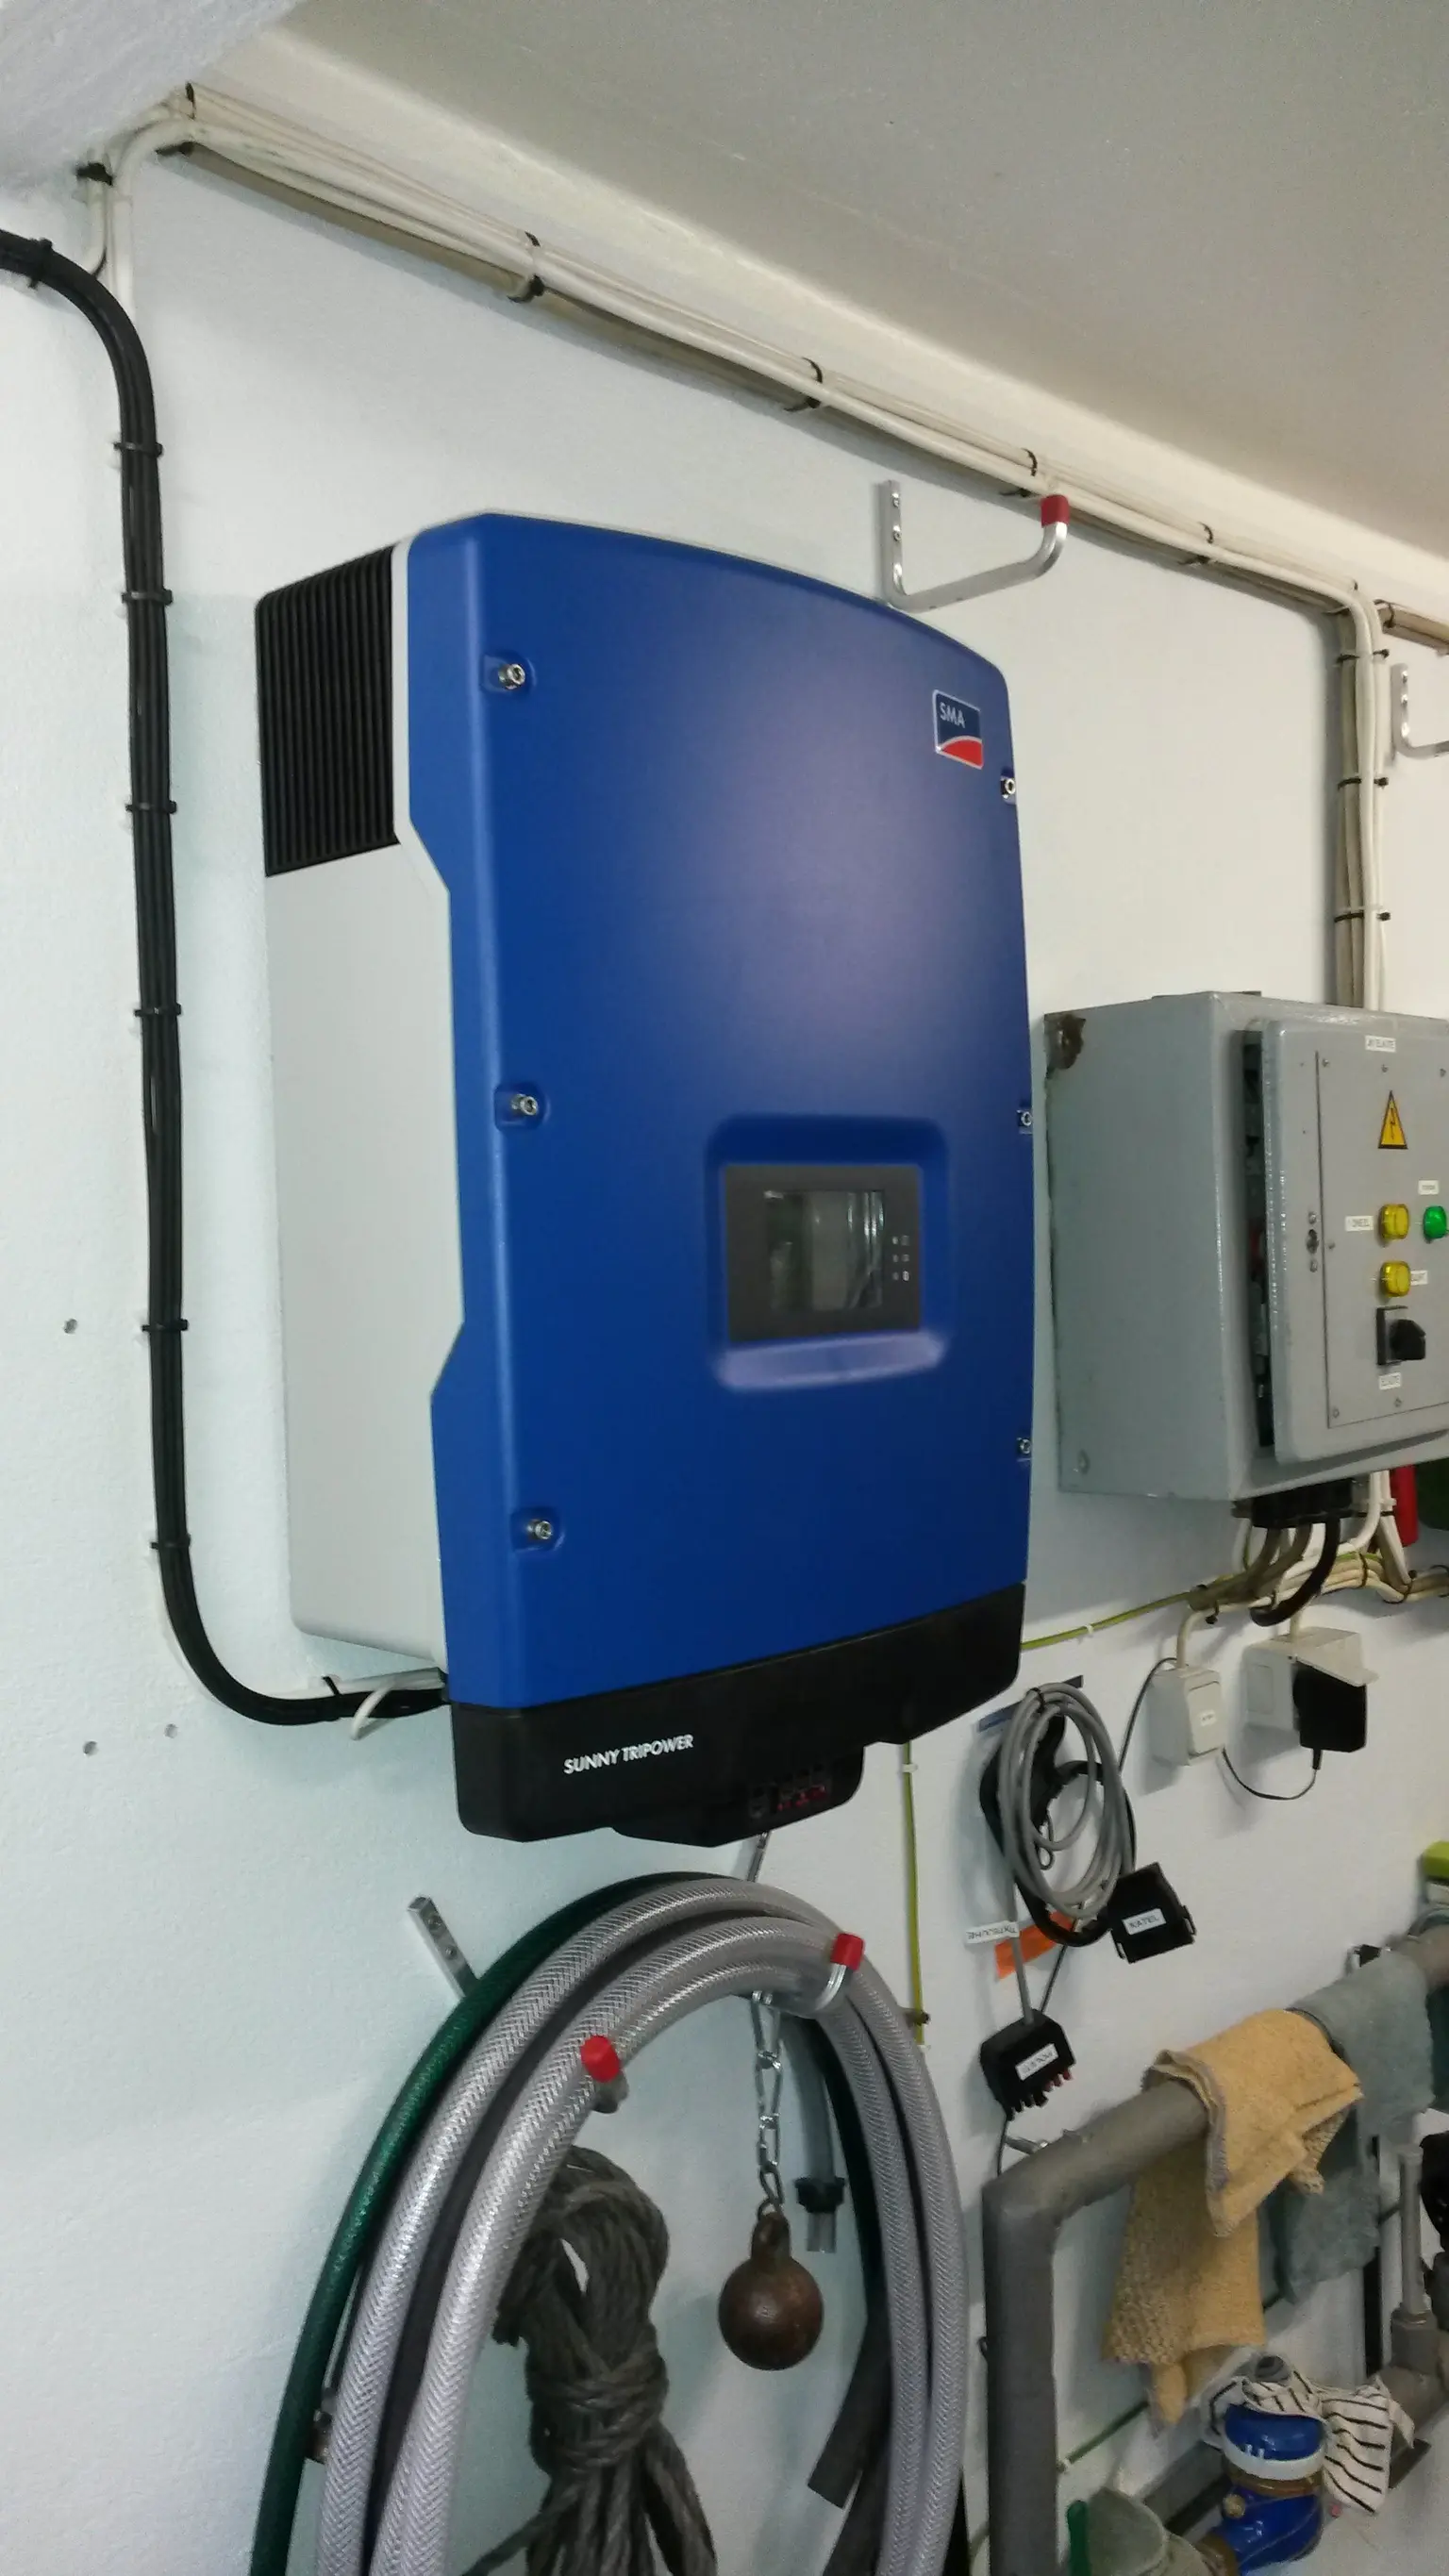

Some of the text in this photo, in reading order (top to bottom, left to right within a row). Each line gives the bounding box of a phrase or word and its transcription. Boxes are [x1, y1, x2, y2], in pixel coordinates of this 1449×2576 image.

[940, 702, 965, 728] SMA
[564, 1734, 693, 1774] SUNNY TRIPOWER
